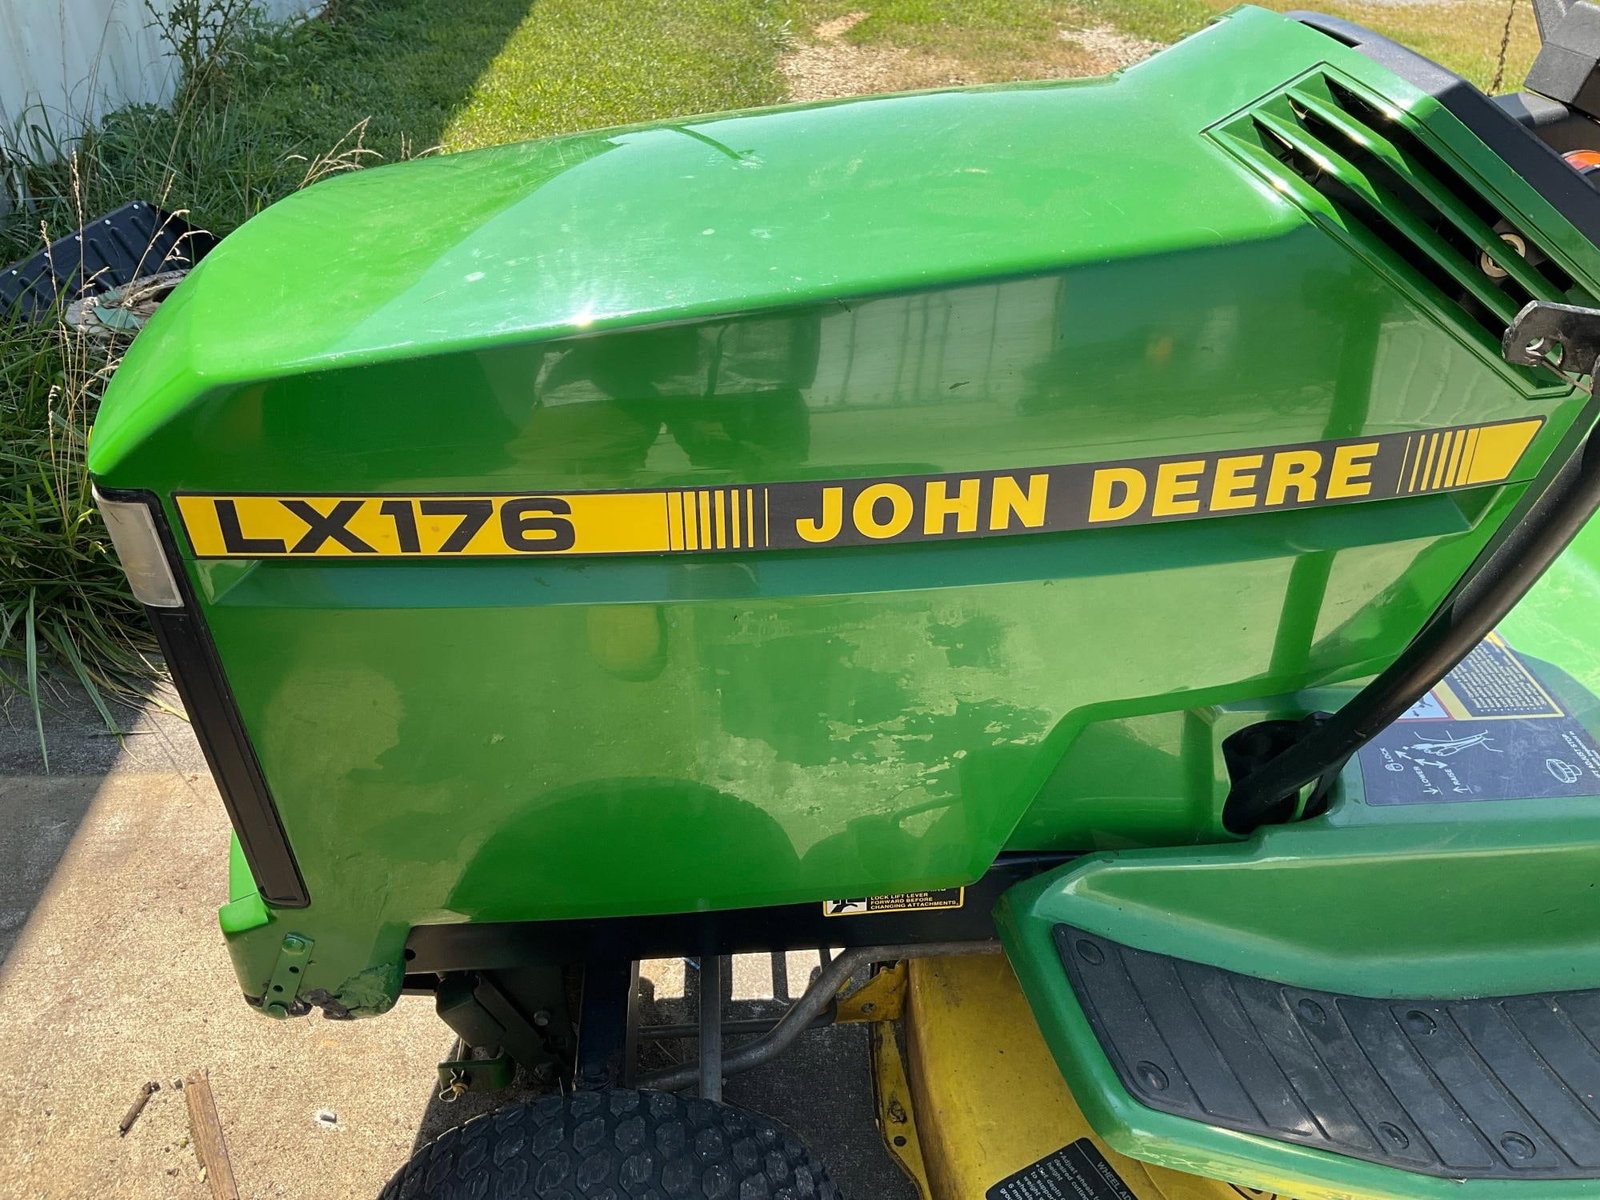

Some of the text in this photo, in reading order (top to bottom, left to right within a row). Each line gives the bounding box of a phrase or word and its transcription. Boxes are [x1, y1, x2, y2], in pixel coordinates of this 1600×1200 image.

[795, 442, 1380, 542] JOHN DEERE
[212, 497, 576, 554] LX176
[1380, 747, 1394, 763] LOCK
[1413, 766, 1432, 787] LOWER
[1444, 768, 1461, 786] RAISE
[1046, 1162, 1063, 1181] height
[1053, 1159, 1074, 1181] desired
[1061, 1155, 1078, 1174] Adjust
[1076, 1175, 1095, 1196] wheels
[1097, 1161, 1120, 1190] WHEEL
[1024, 1175, 1041, 1196] weight
[1036, 1179, 1056, 1200] suppor
[1047, 1179, 1062, 1197] depth
